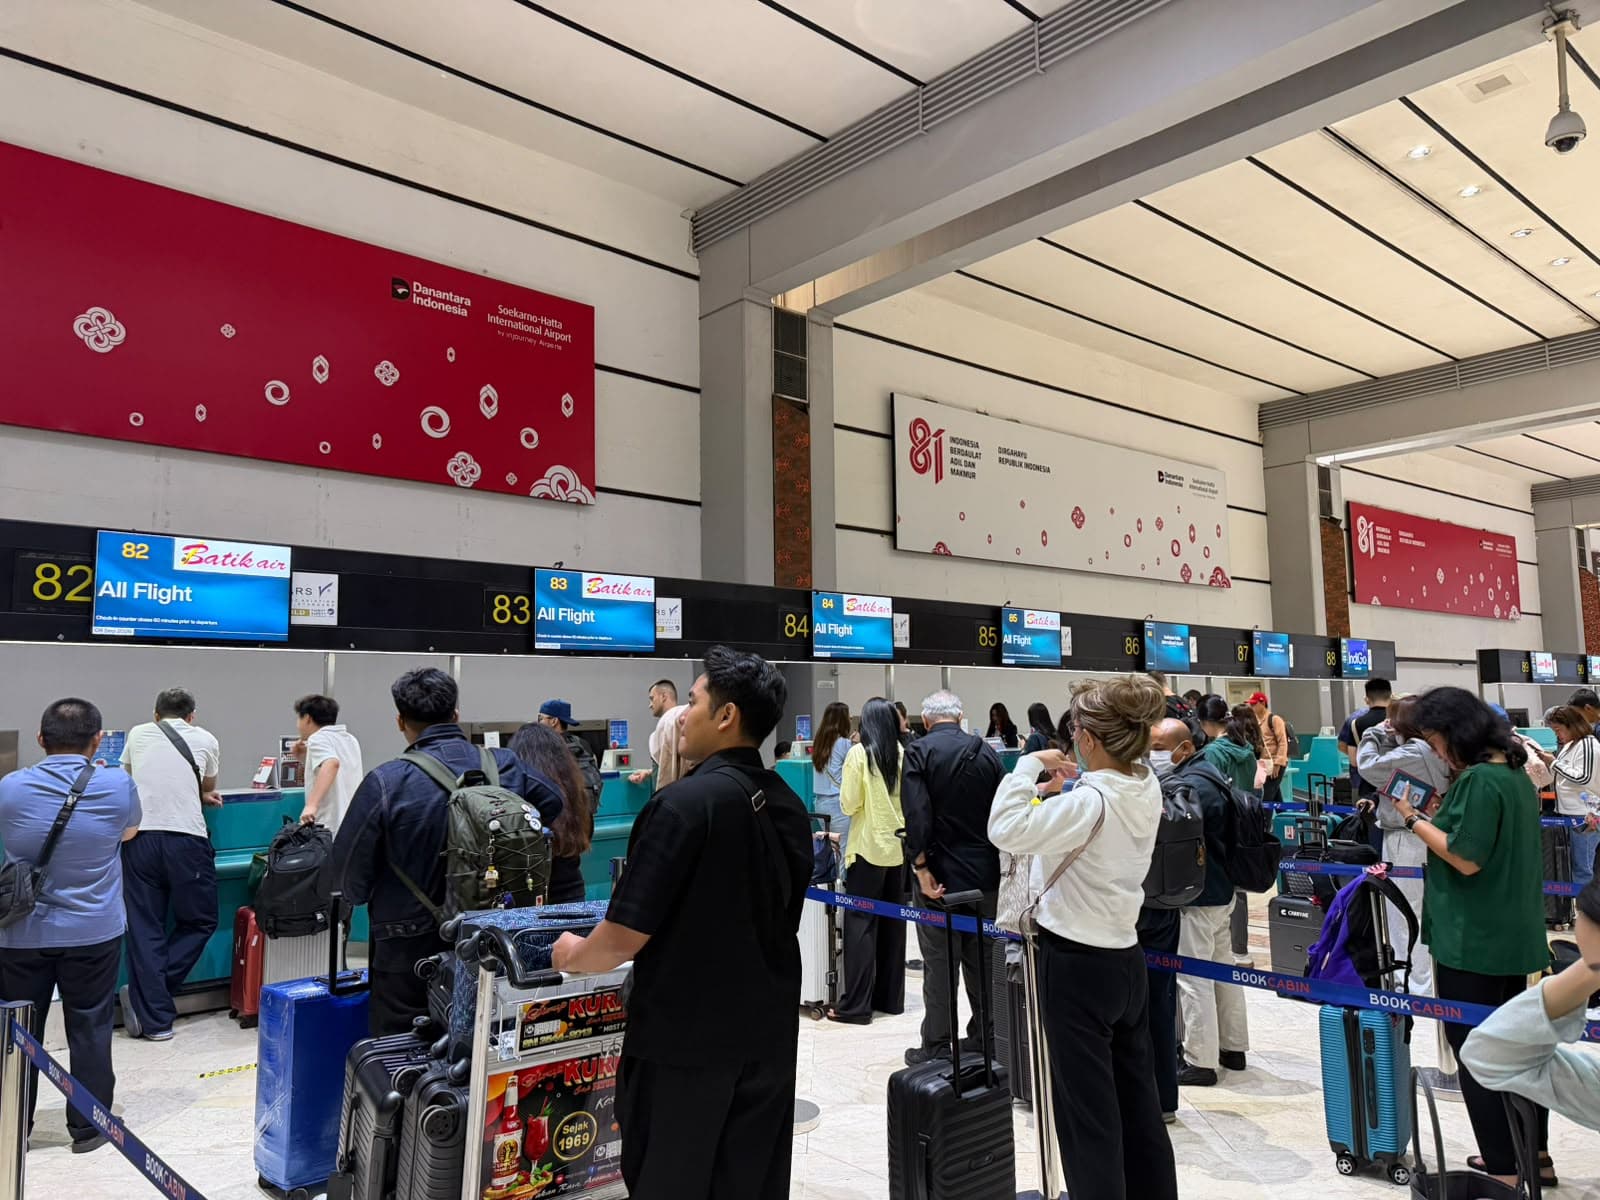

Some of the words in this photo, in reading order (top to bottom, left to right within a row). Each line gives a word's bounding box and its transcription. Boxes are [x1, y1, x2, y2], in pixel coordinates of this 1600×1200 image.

[412, 281, 471, 306] Danantara
[412, 293, 469, 317] Indonesia
[498, 304, 563, 330] Soekarno-Hatta
[487, 313, 542, 335] International
[544, 328, 572, 343] Airport
[909, 417, 946, 485] 81
[949, 435, 980, 449] INDONESIA
[949, 446, 982, 460] BERDAULAT
[950, 457, 963, 467] ADIL
[963, 459, 976, 469] DAN
[950, 468, 976, 480] MAKMUR
[998, 456, 1024, 469] REPUBLIK
[1024, 461, 1051, 474] INDONESIA
[121, 541, 149, 560] 82
[180, 540, 257, 567] Batik
[257, 556, 288, 571] air
[32, 562, 94, 602] 82
[97, 580, 128, 599] All
[133, 582, 194, 605] Flight
[550, 577, 568, 590] 83
[587, 576, 633, 596] Batik
[633, 587, 652, 597] air
[492, 594, 531, 624] 83
[537, 607, 556, 621] All
[559, 608, 595, 625] Flight
[822, 598, 834, 609] 84
[846, 598, 877, 613] Batik
[784, 613, 809, 638] 84
[814, 623, 827, 634] All
[829, 624, 853, 637] Flight
[979, 626, 997, 647] 85
[1003, 634, 1012, 644] All
[1013, 635, 1032, 647] Flight
[1125, 636, 1140, 655] 86
[1237, 645, 1249, 662] 87
[1326, 651, 1336, 666] 88
[835, 895, 875, 910] BOOKCABIN
[900, 908, 945, 924] BOOKCABIN
[1232, 970, 1310, 993] BOOKCABIN
[568, 992, 623, 1019] KUR
[1369, 992, 1464, 1019] BOOKCABIN
[48, 1062, 74, 1096] BOOKCABIN
[93, 1105, 125, 1147] BOOKCABIN
[562, 1120, 589, 1135] Sejak
[558, 1133, 590, 1151] 1969
[145, 1153, 187, 1200] BOOKCABIN
